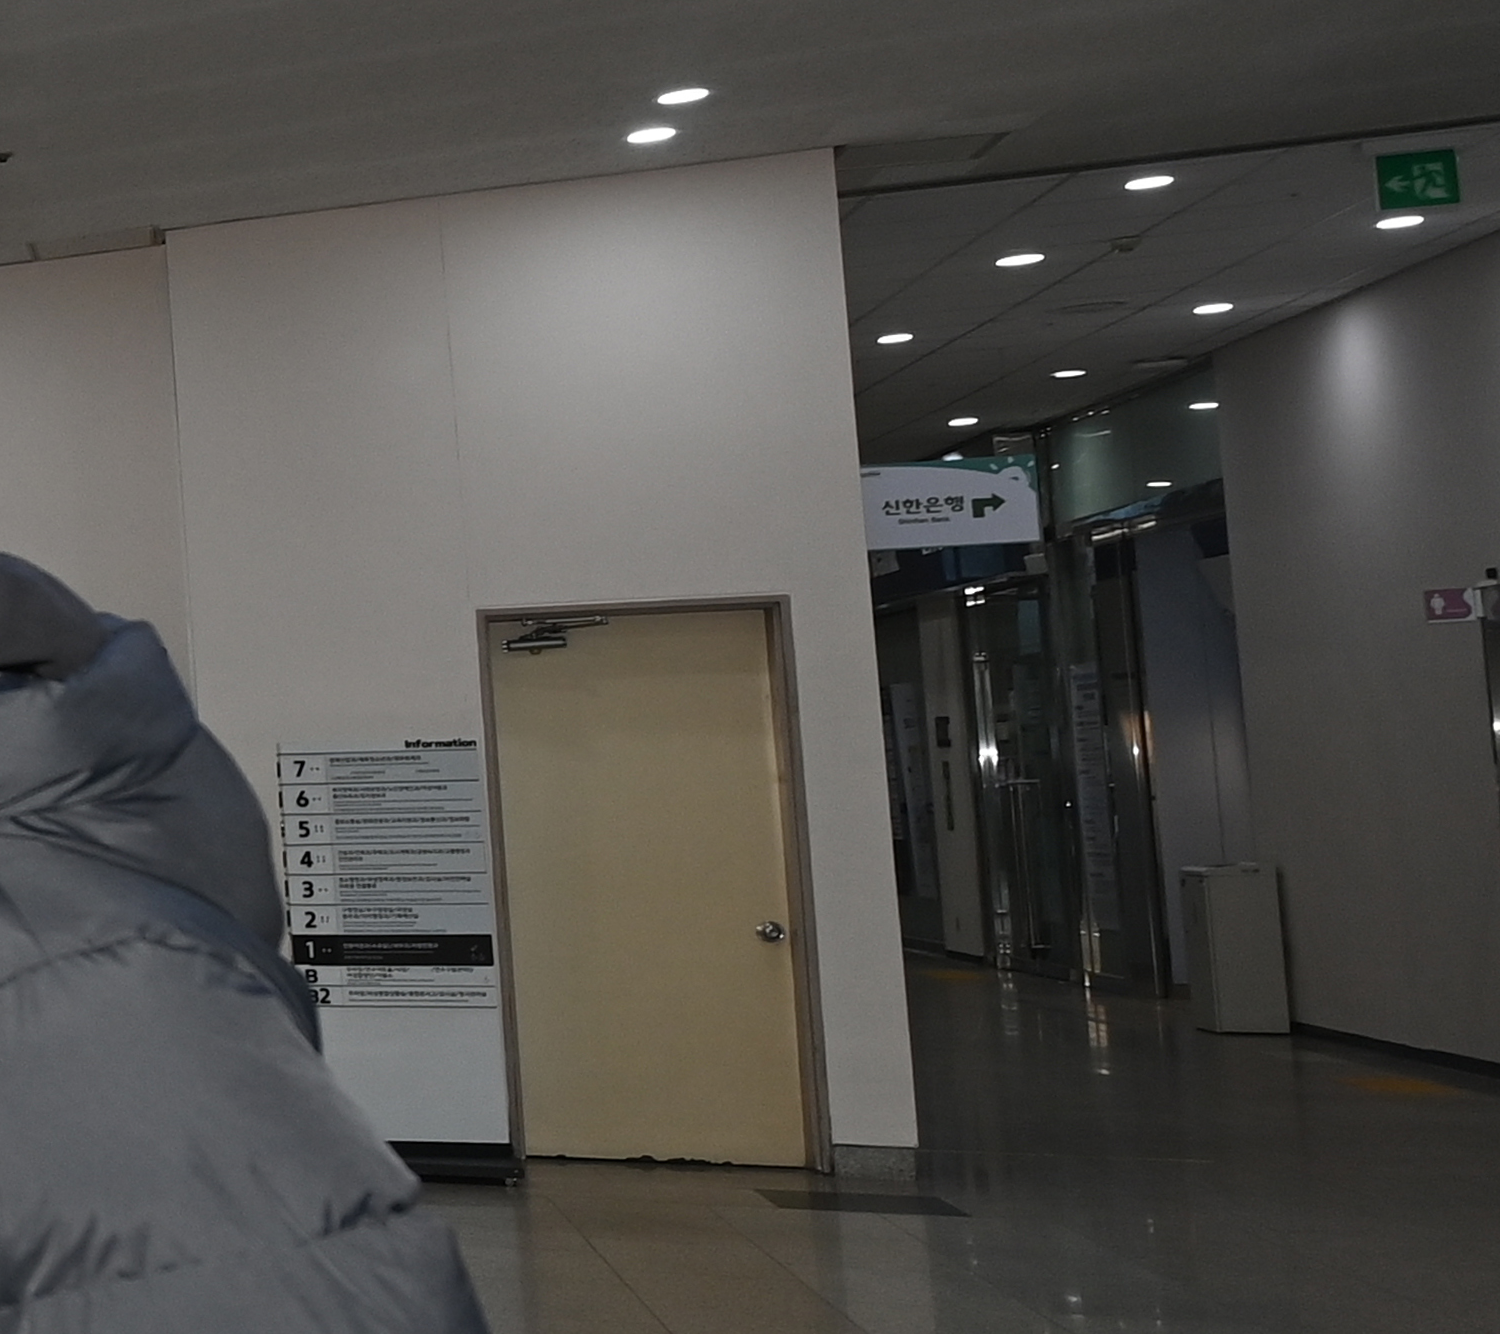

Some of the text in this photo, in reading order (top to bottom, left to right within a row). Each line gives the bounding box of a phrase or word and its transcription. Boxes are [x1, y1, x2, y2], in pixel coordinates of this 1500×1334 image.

[882, 496, 964, 515] 신한은행
[404, 738, 477, 748] Information
[293, 760, 306, 777] 7
[296, 790, 309, 808] 6
[298, 821, 310, 838] 5
[300, 851, 313, 868] 4
[302, 881, 314, 898] 3
[304, 911, 317, 928] 2
[305, 941, 315, 959] 1
